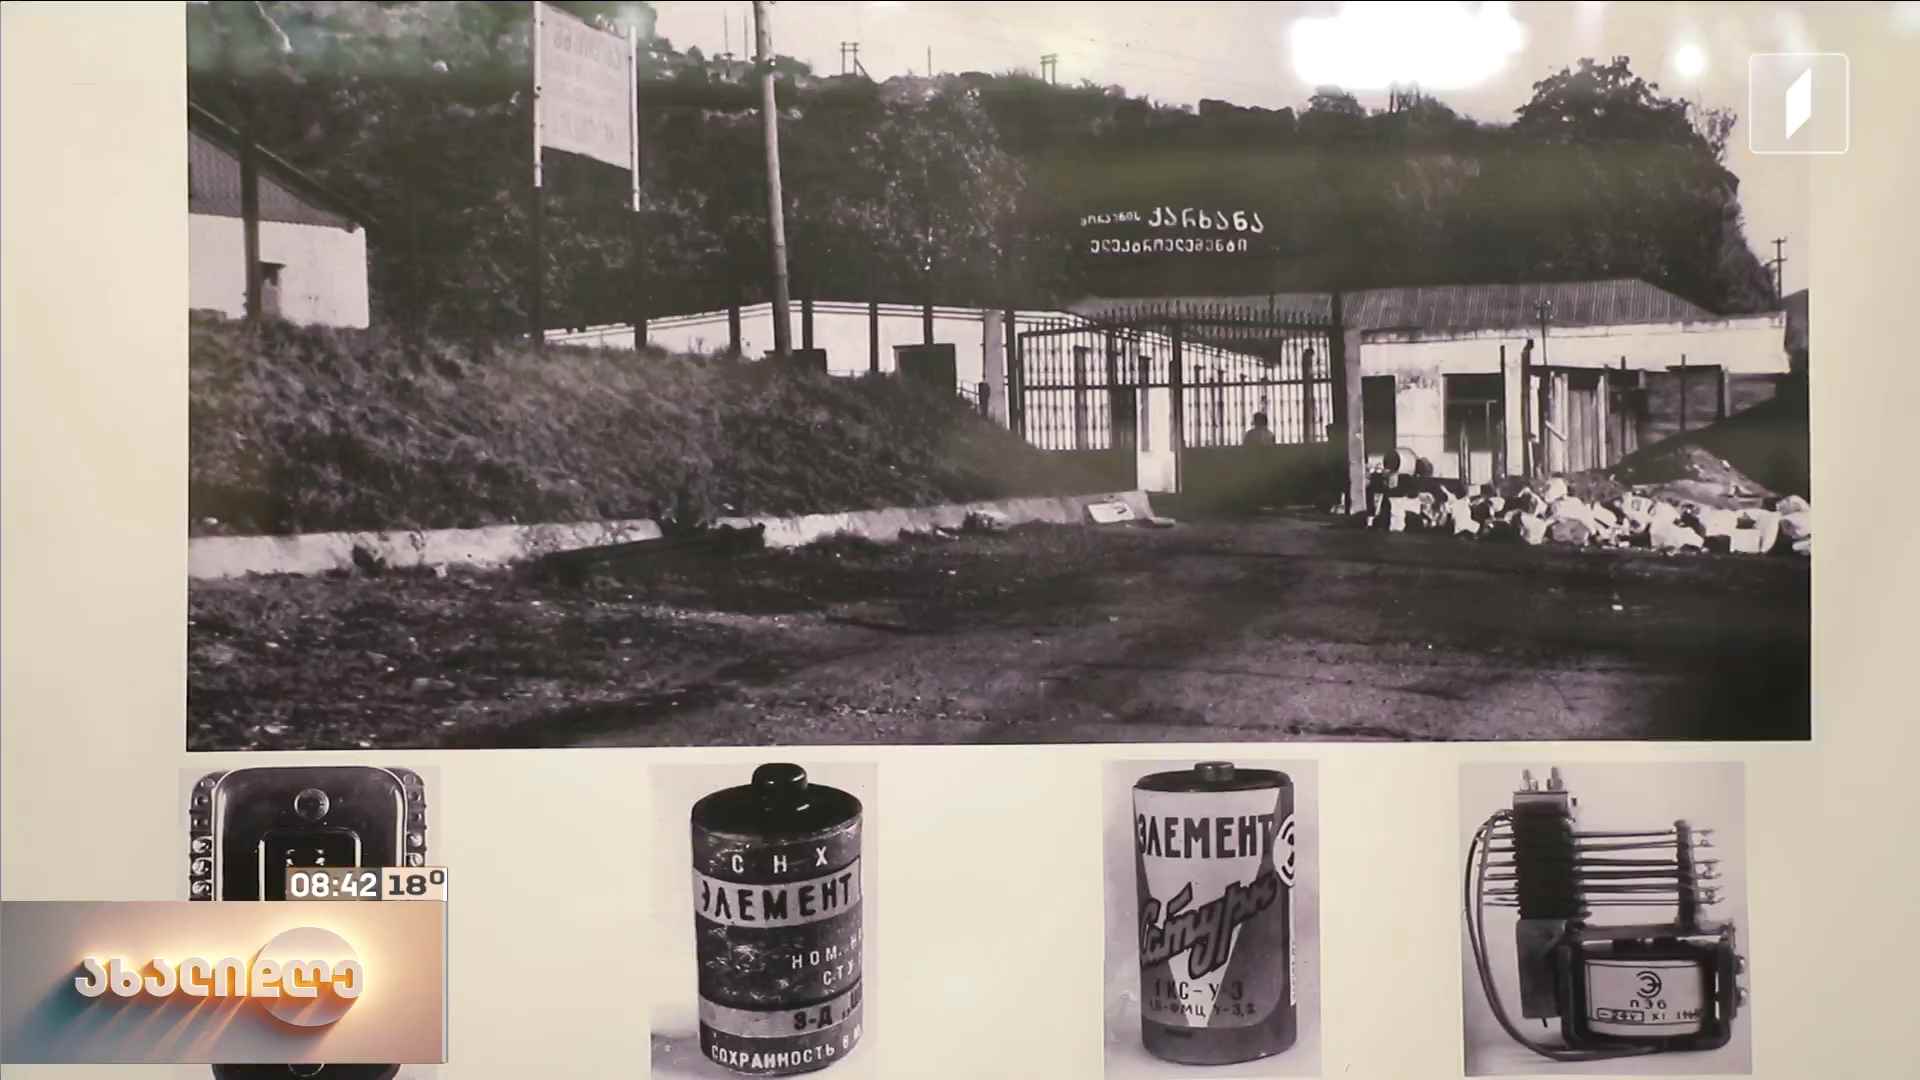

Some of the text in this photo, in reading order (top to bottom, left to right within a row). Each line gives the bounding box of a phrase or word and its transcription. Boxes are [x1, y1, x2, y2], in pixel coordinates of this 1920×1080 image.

[1149, 206, 1265, 234] ქარხანა
[1138, 813, 1274, 859] ЭЛЕМЕНТ
[701, 872, 852, 922] ЭЛЕМЕНТ
[711, 1043, 835, 1071] СОХРАННОСТЬ
